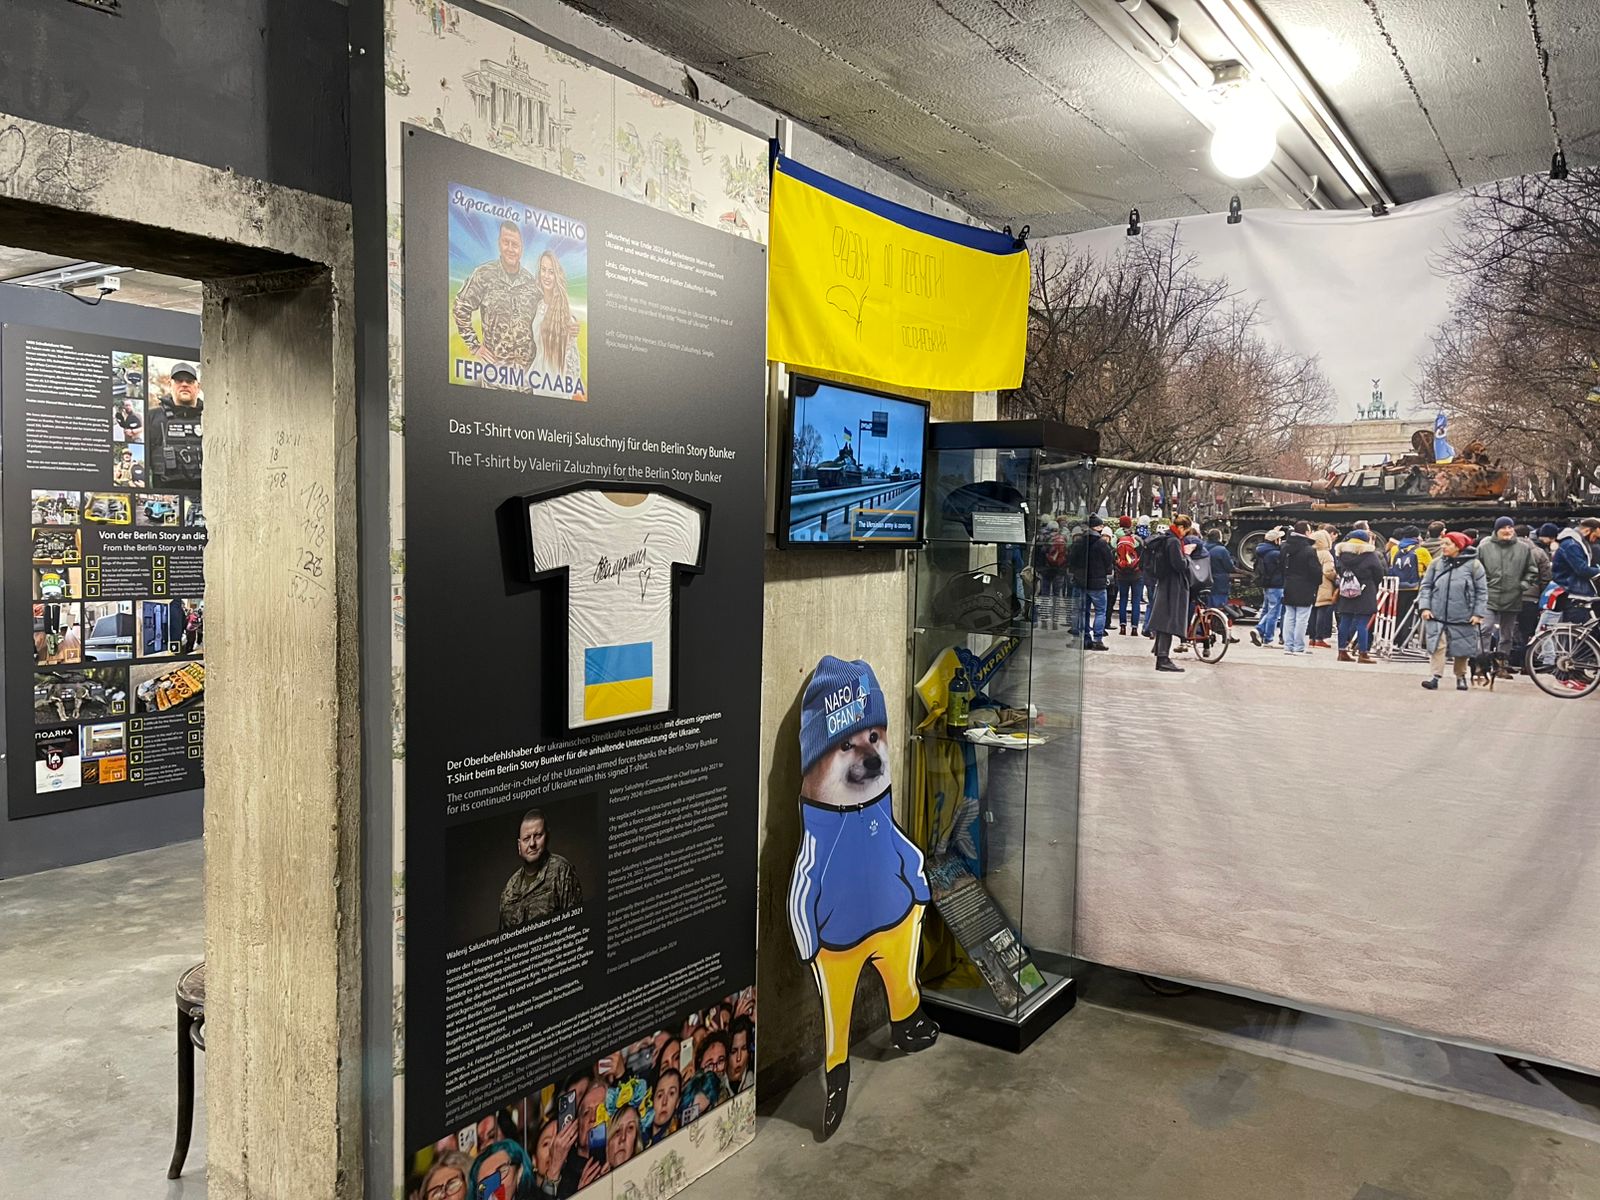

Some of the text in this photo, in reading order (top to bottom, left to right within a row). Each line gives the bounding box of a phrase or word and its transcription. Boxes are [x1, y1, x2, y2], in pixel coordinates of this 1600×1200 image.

[453, 190, 586, 240] Ярослава РУДЕНКО
[456, 359, 585, 395] ГЕРОЯМ СЛАВА
[449, 419, 736, 459] Das T-Shirt von Walerij Saluschnyj für den Berlin Story Bunker
[449, 451, 722, 484] The T-shirt by Valerii Zaluzhnyi for the Berlin Story Bunker
[99, 531, 116, 539] Von
[118, 531, 132, 539] der
[134, 531, 157, 539] Berlin
[160, 532, 180, 541] Story
[825, 686, 851, 714] NAFO
[828, 706, 854, 733] OFAN
[35, 729, 73, 739] ПОДЯКА
[447, 760, 461, 771] Der
[463, 747, 533, 767] Oberbefehlshaber
[534, 744, 545, 754] der
[547, 737, 590, 751] ukrainischen
[592, 731, 626, 743] Streitkräfte
[664, 720, 674, 728] mit
[675, 717, 695, 727] diesem
[696, 712, 722, 724] signierten
[447, 727, 700, 785] T-Shirt beim Berlin Story Bunker für die anhaltende Unterstützung der Ukraine.
[447, 738, 718, 803] The commander-in-chief of the Ukrainian armed forces thanks the Berlin Story Bunker
[446, 762, 649, 815] for its continued support of Ukraine with this signed T-shirt.
[447, 906, 582, 961] Walerij Saluschnyj (Oberbefehlshaber seit Juli 2021
